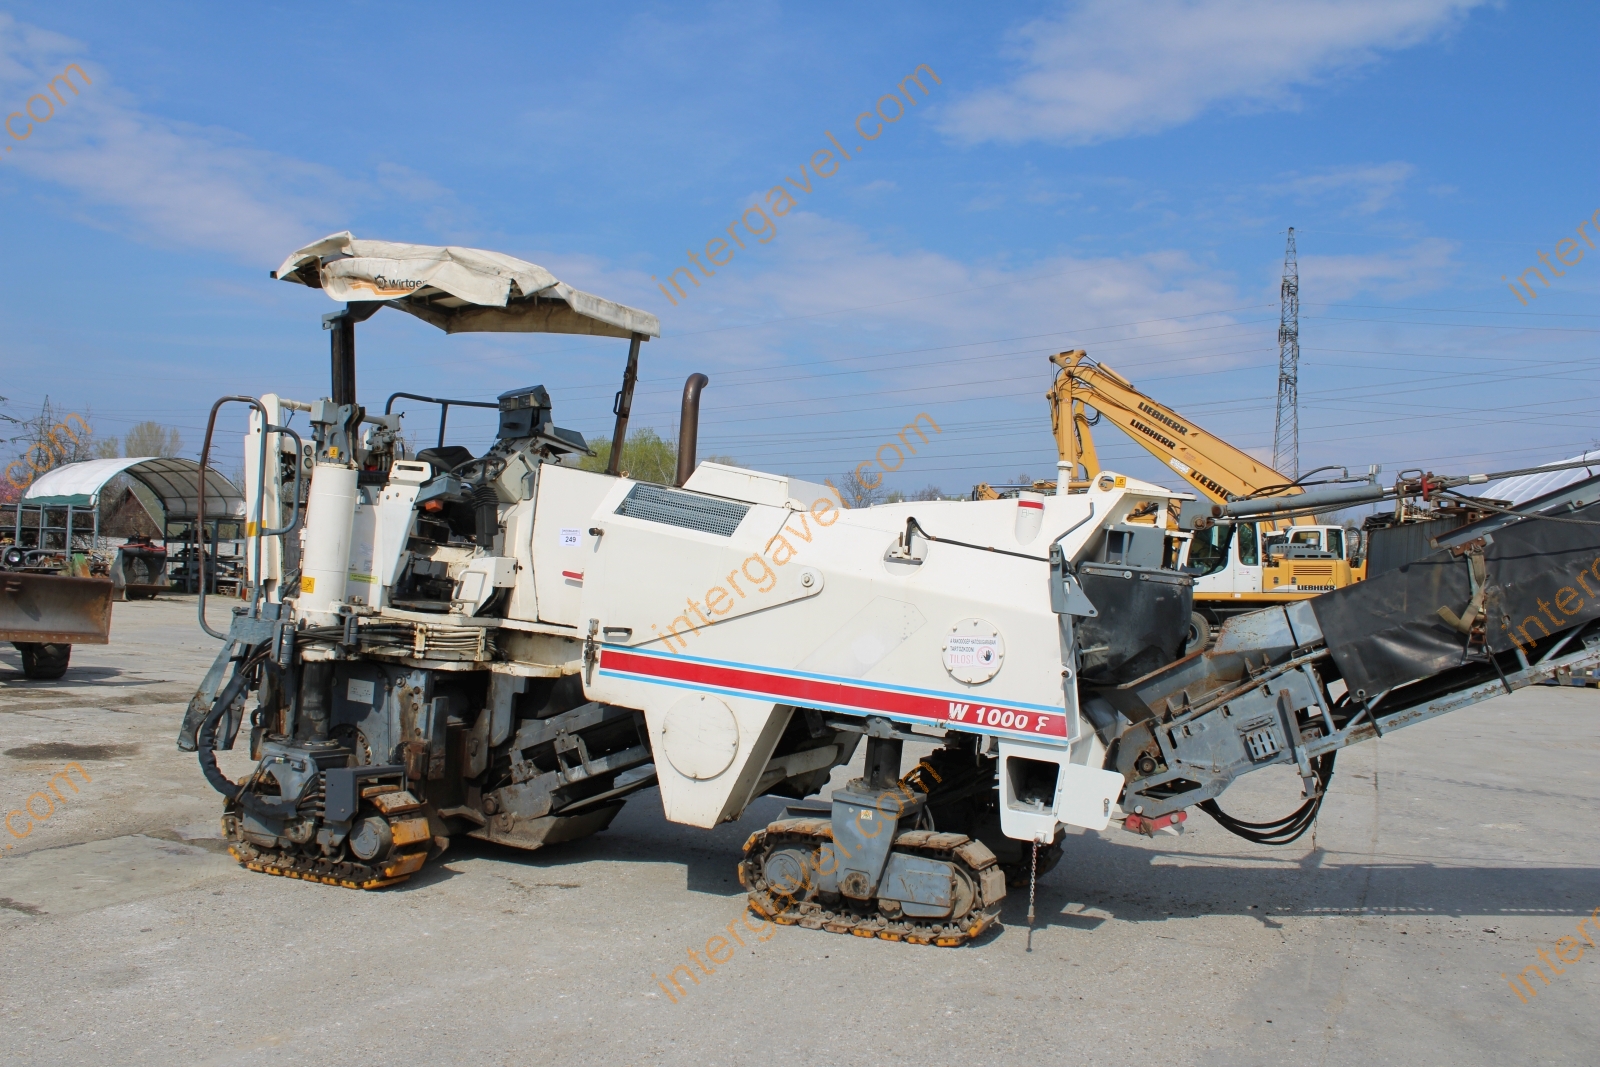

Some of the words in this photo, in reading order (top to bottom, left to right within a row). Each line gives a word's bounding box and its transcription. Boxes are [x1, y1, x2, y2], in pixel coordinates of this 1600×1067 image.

[1137, 401, 1188, 436] LIEBHERR
[1130, 418, 1176, 450] LIEBHERR
[950, 654, 974, 664] TILOS!
[949, 702, 969, 721] W
[976, 707, 1028, 729] 1000
[1035, 716, 1050, 731] F
